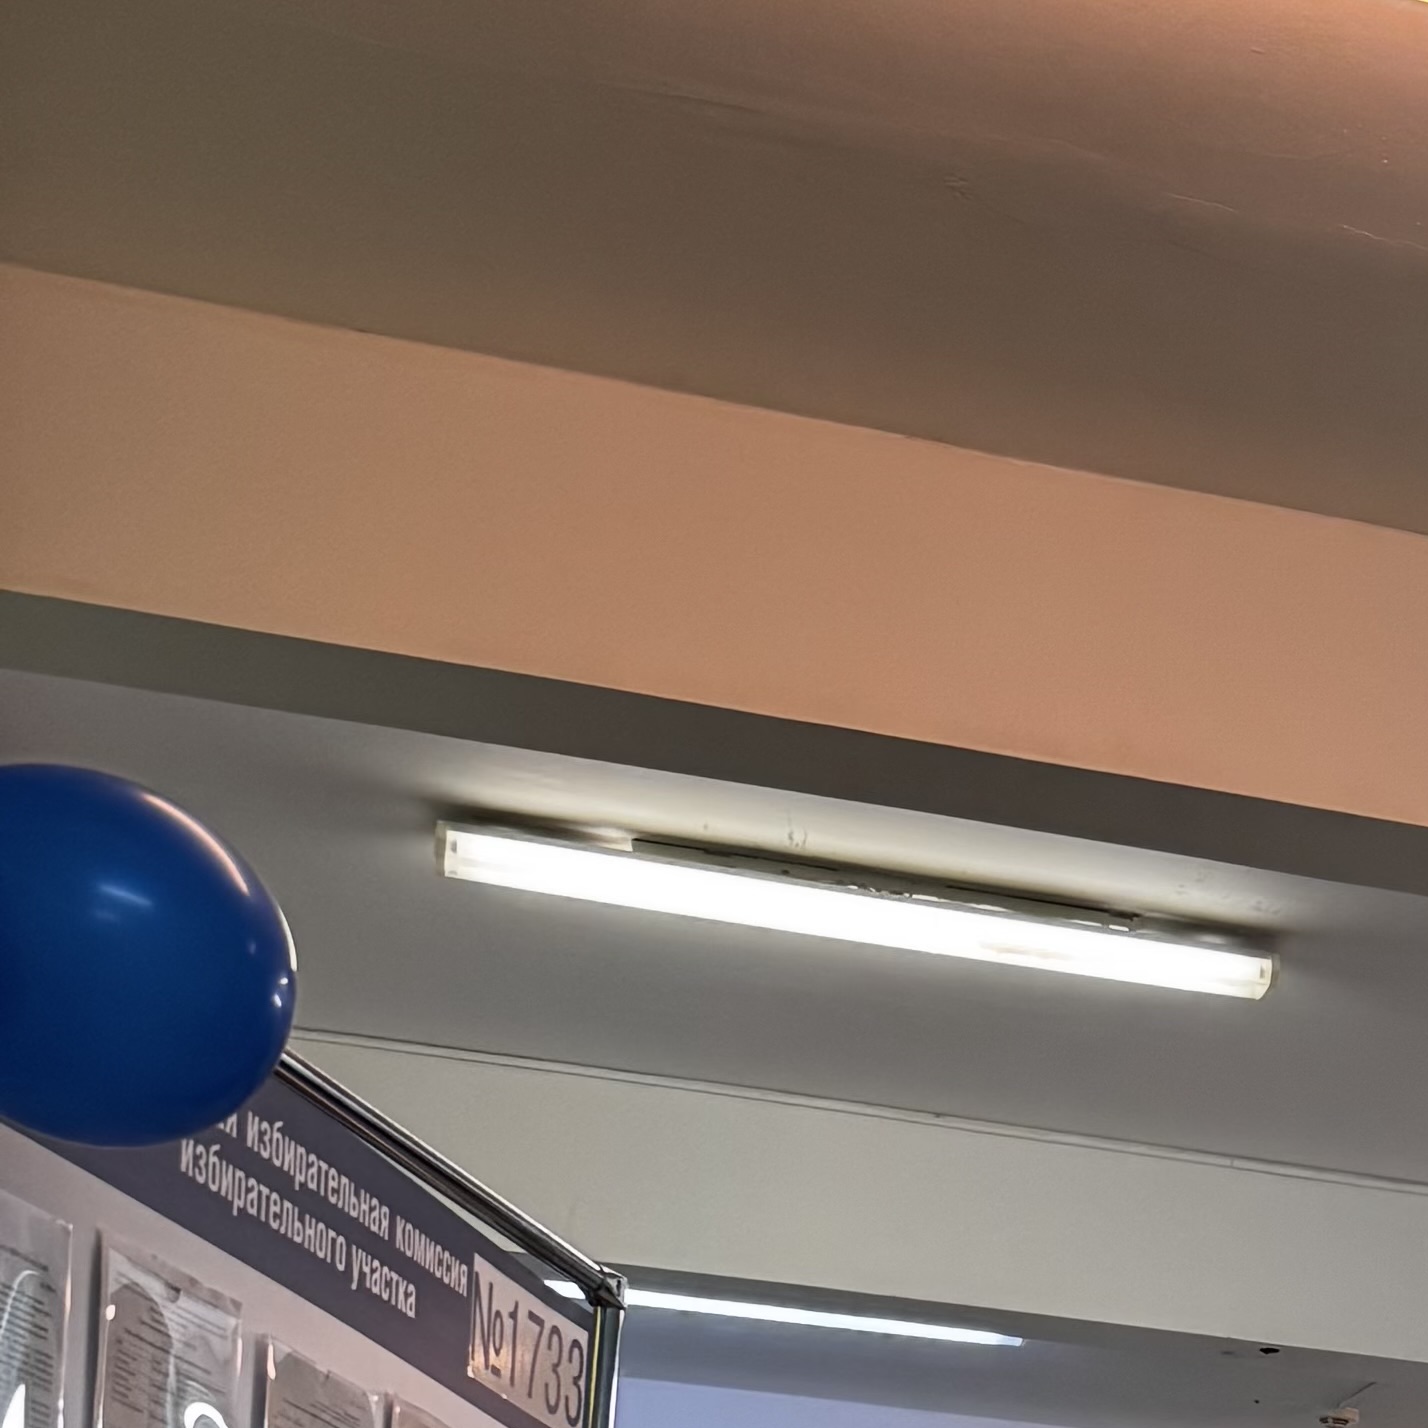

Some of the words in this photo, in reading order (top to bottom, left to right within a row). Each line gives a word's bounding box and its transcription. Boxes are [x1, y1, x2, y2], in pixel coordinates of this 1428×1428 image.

[180, 1138, 347, 1272] избирательного
[351, 1244, 416, 1319] участка
[247, 1110, 390, 1241] избирательная
[396, 1215, 468, 1297] комиссия
